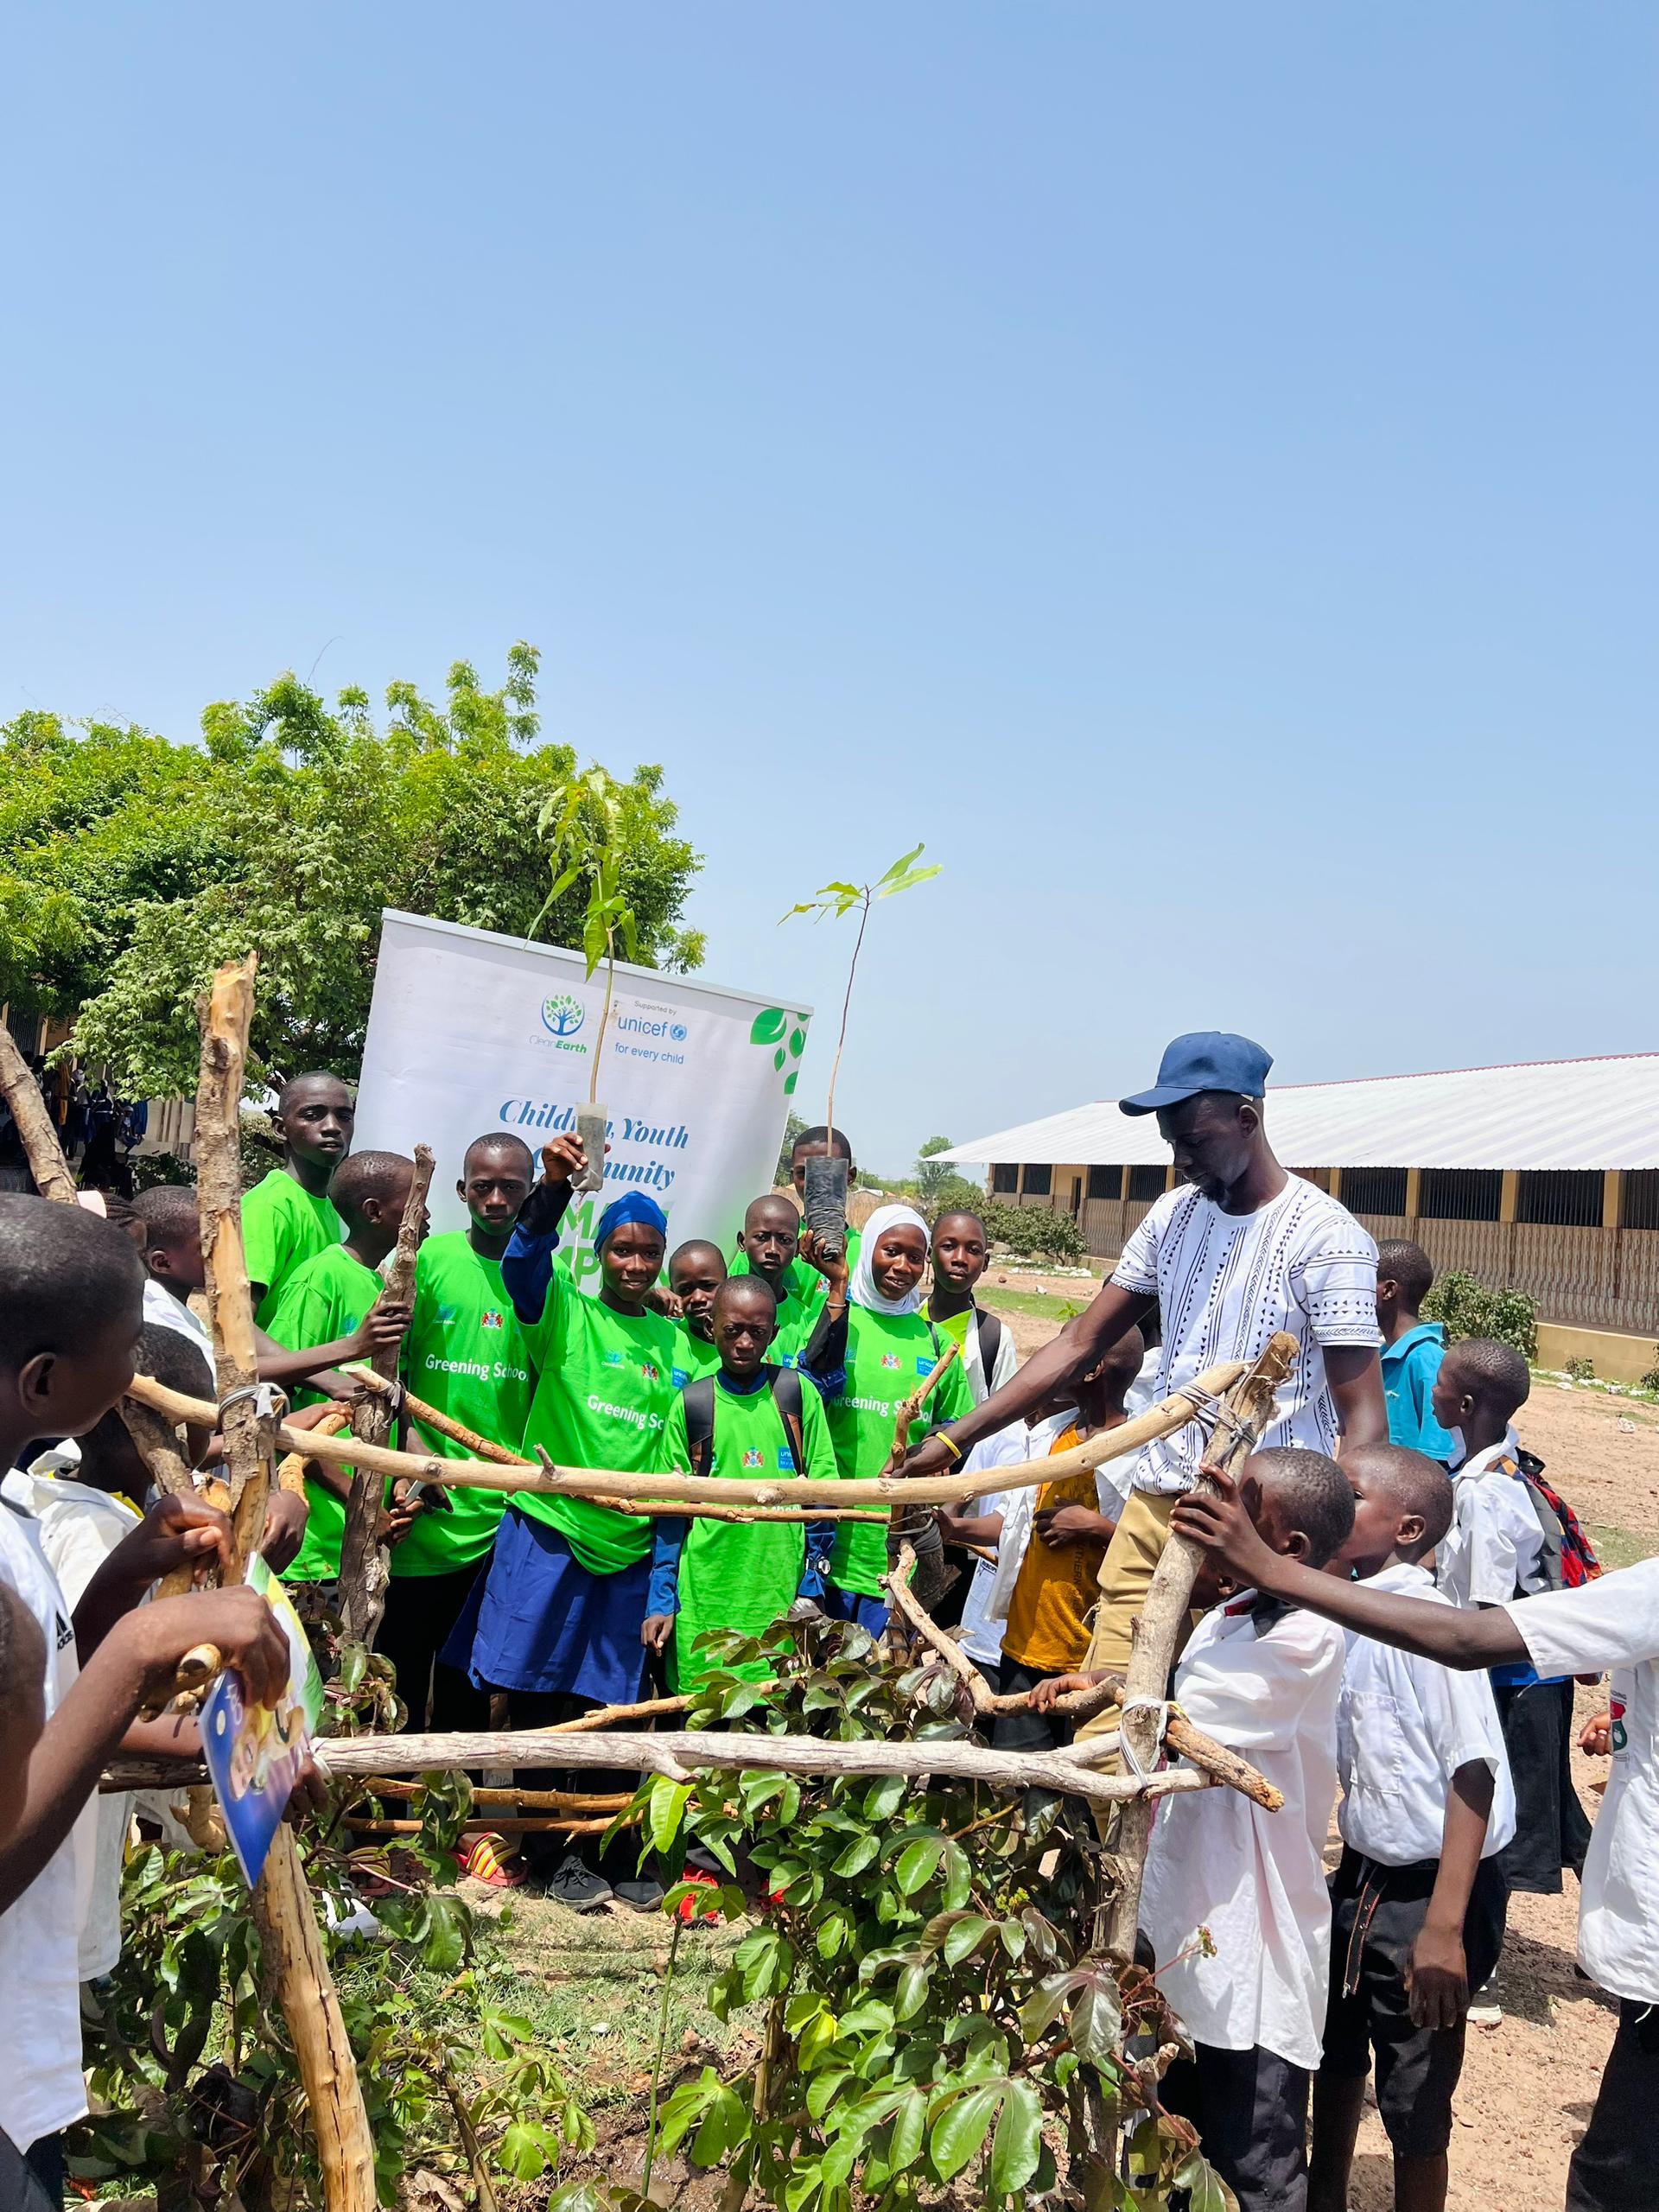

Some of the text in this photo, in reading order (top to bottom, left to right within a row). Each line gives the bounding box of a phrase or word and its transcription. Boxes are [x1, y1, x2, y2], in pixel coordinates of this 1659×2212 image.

[634, 1000, 677, 1016] Supported by
[618, 1016, 668, 1037] unicef
[614, 1042, 684, 1065] for every child
[499, 1099, 690, 1149] Childn, Youth
[532, 1147, 676, 1192] Cunity
[425, 1353, 490, 1382] Greening
[588, 1394, 647, 1430] Greening
